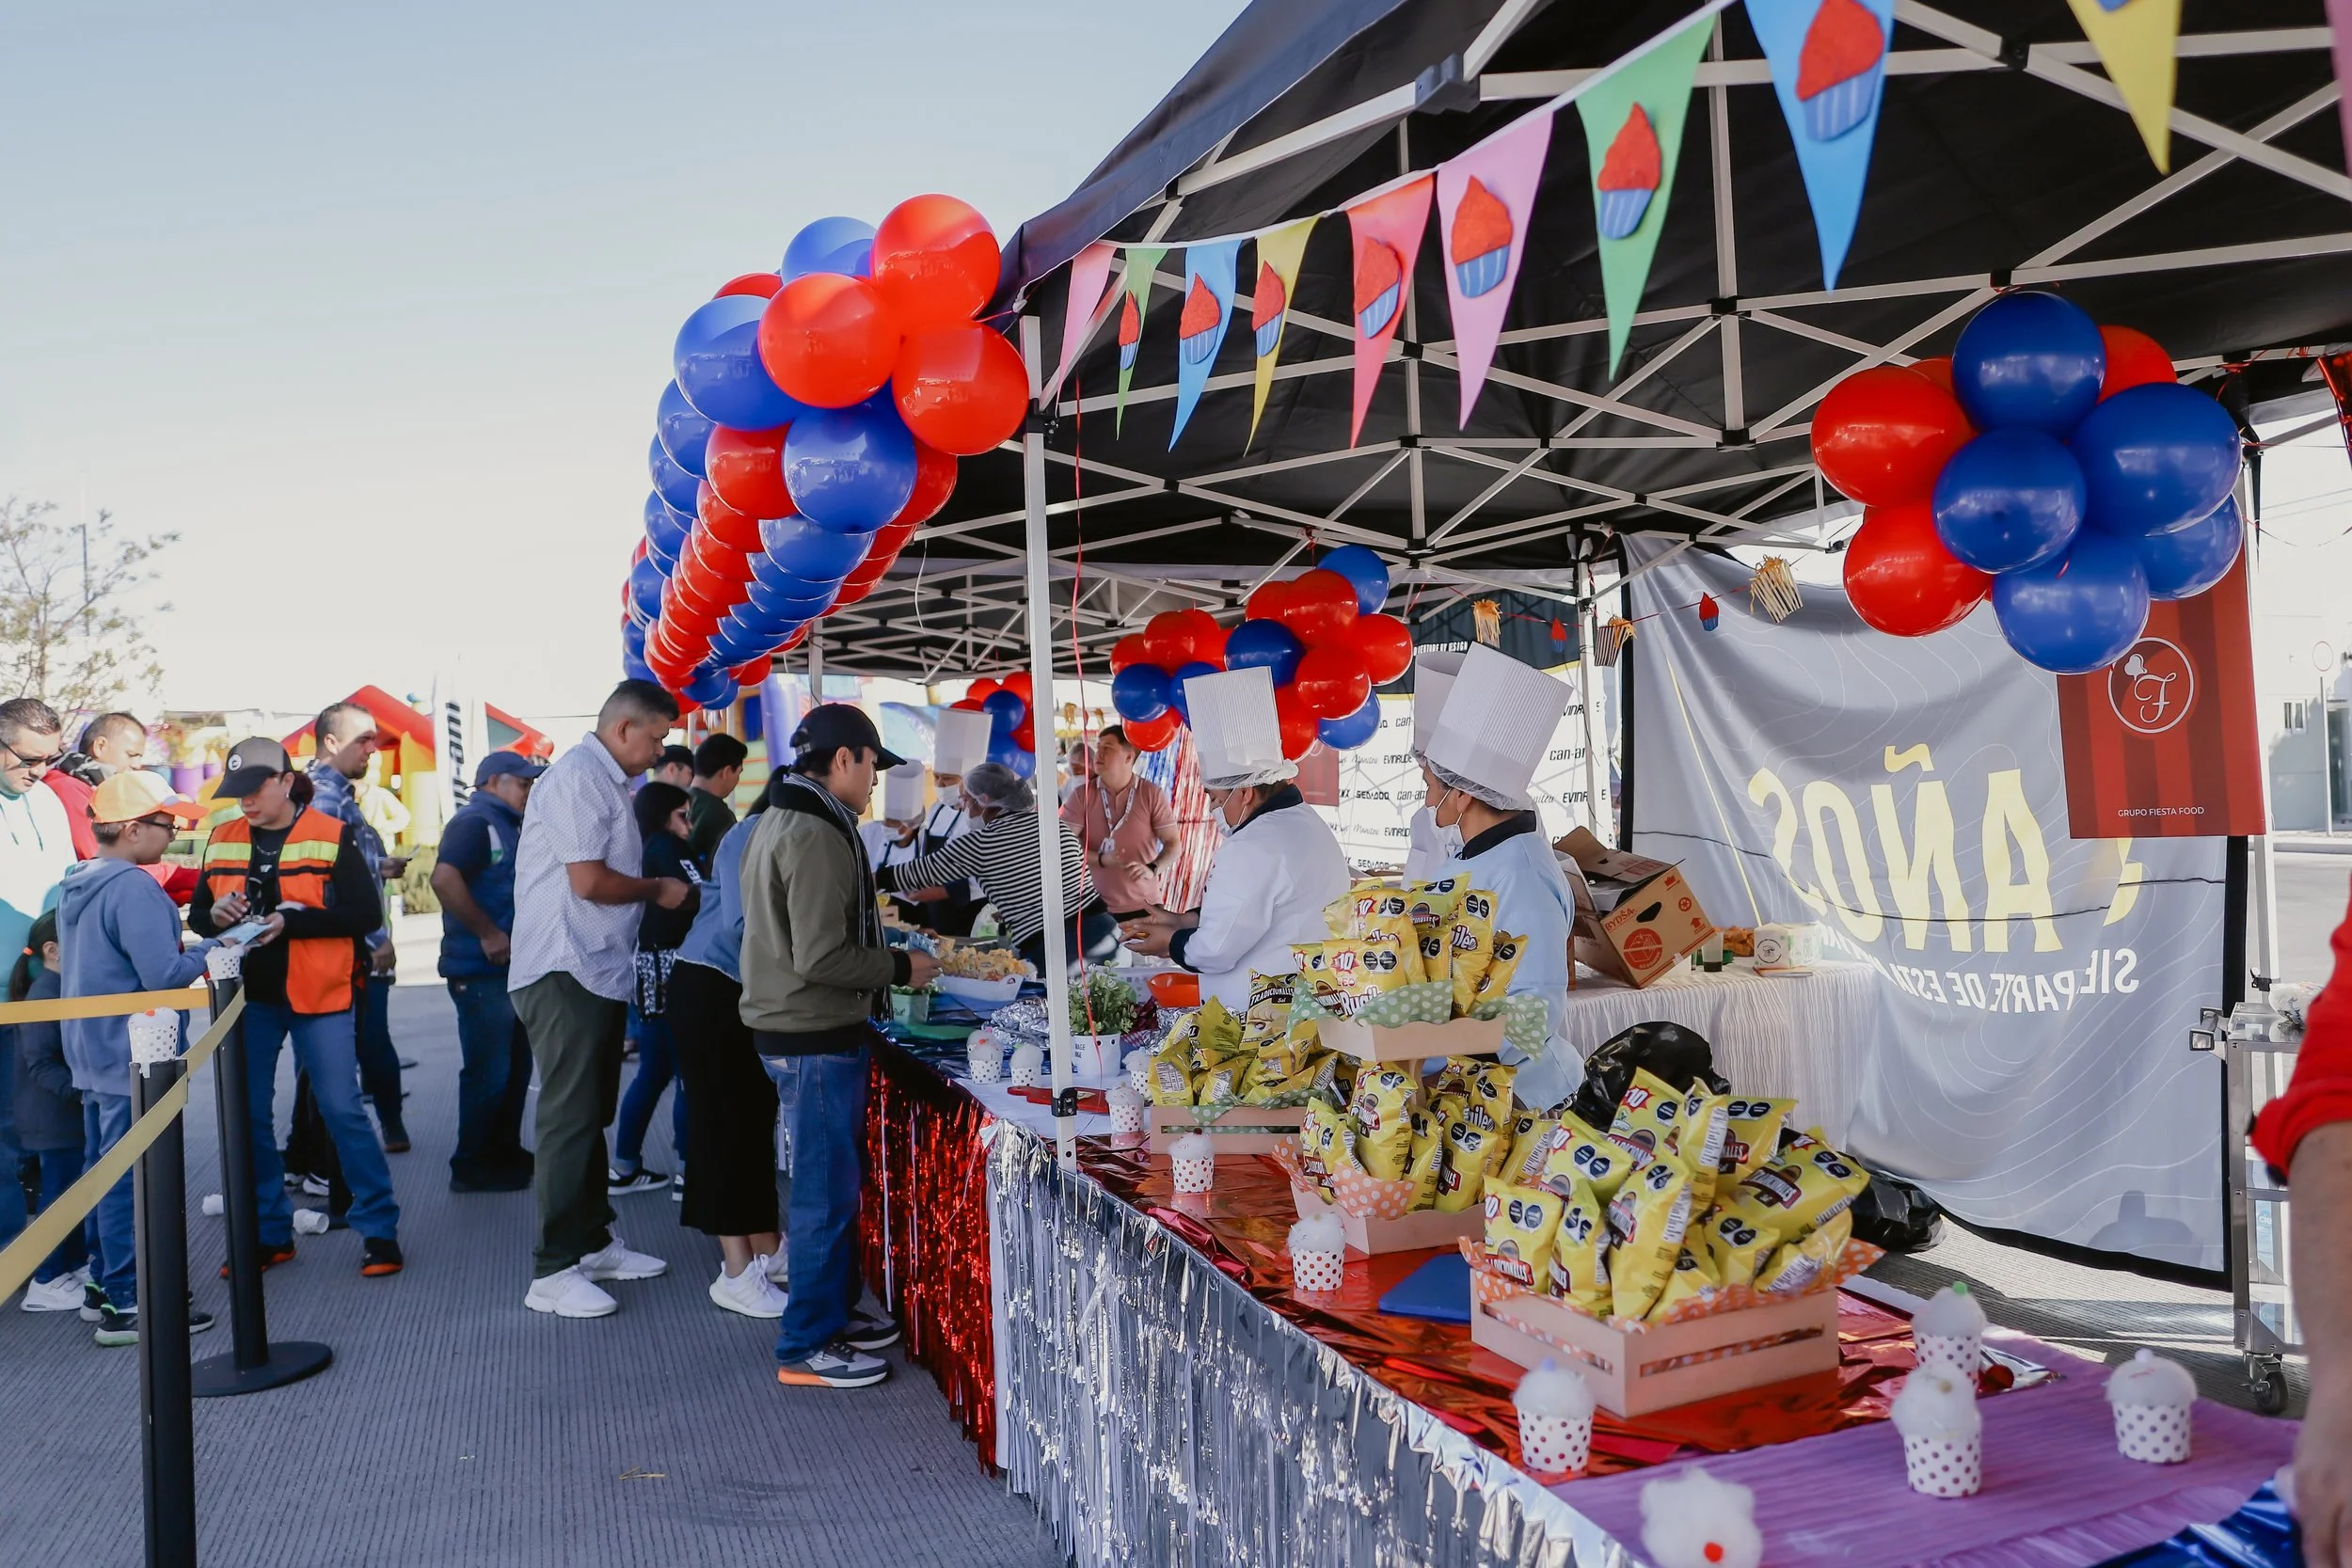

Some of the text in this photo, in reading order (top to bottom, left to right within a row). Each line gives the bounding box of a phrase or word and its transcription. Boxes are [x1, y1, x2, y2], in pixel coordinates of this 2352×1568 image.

[1395, 716, 1414, 728] can-
[2118, 806, 2205, 817] GRUPO FIESTA FOOD
[1384, 827, 1411, 837] EVINRUD
